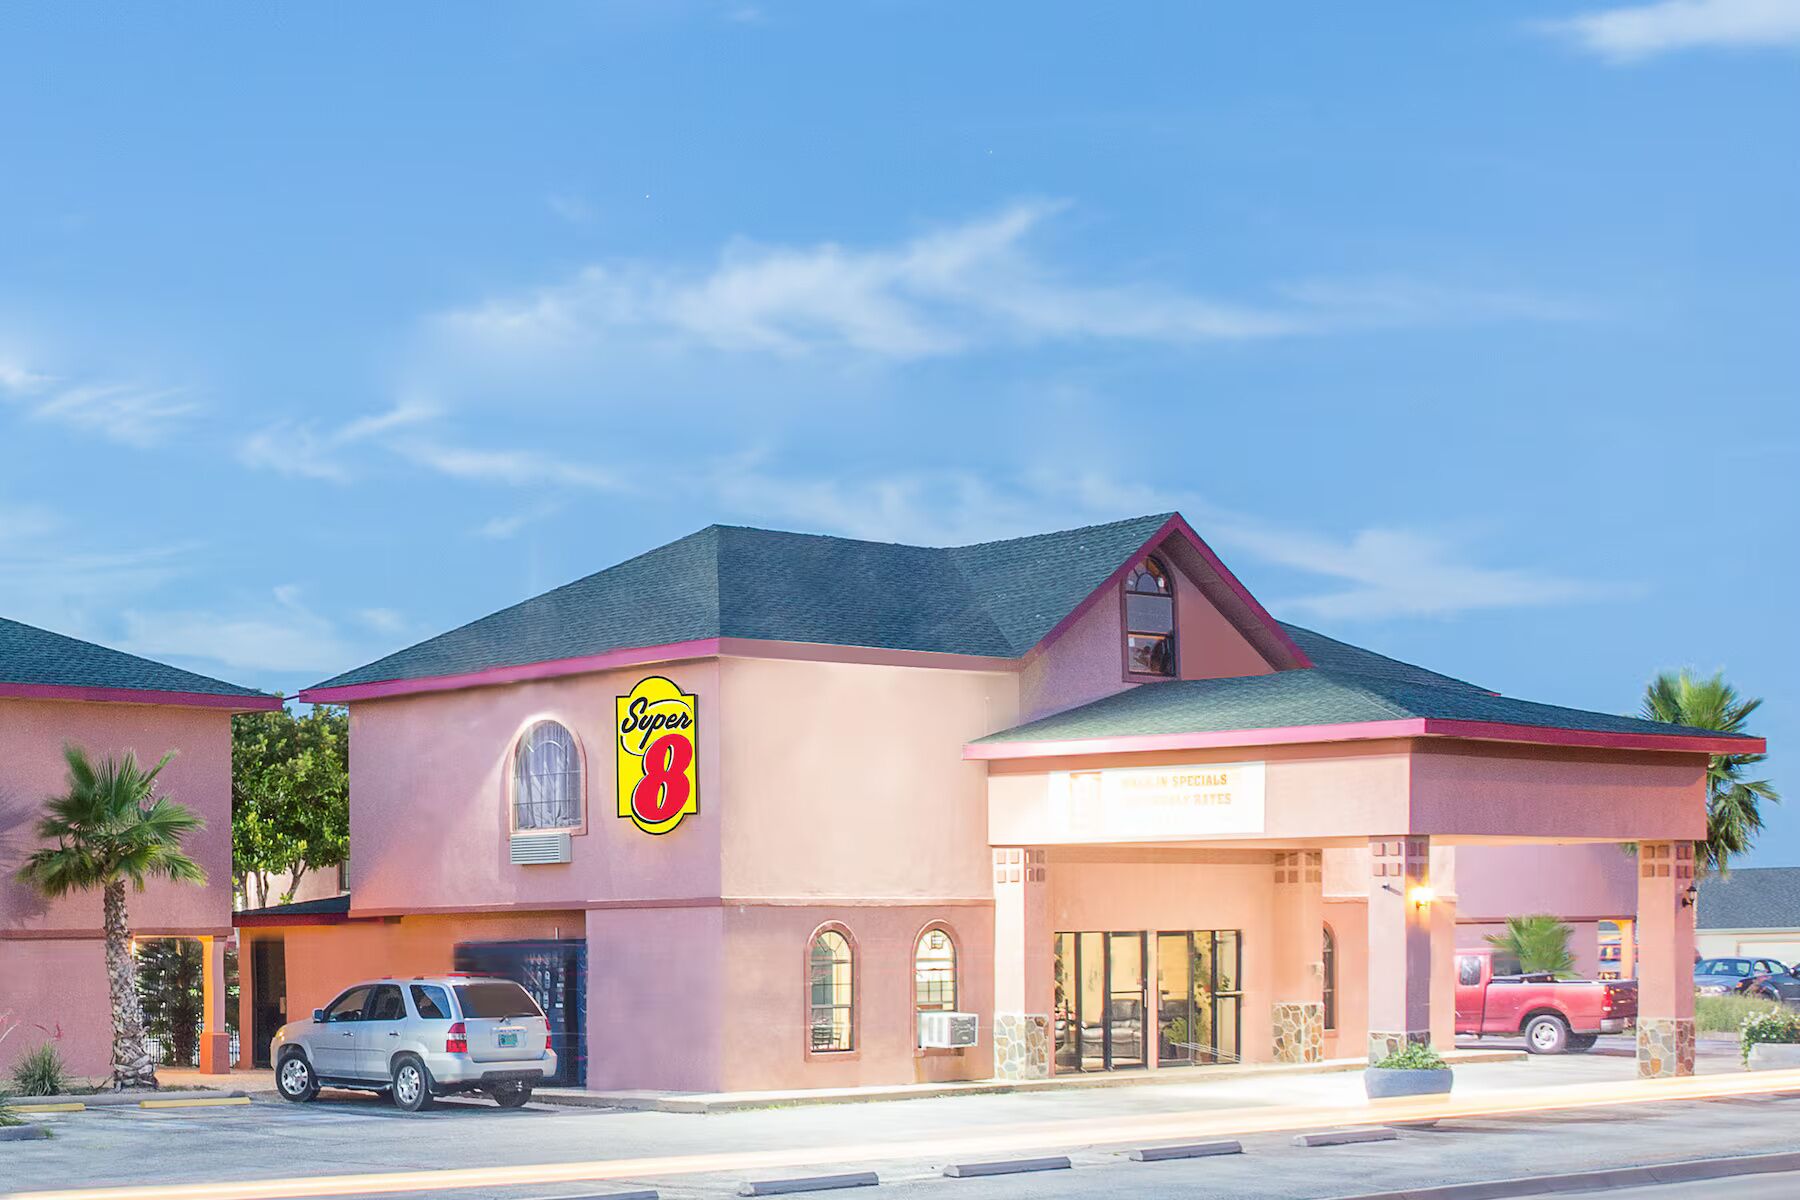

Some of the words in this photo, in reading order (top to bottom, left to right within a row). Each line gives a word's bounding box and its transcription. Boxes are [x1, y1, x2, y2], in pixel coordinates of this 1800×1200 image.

[621, 696, 693, 750] Super
[631, 733, 693, 824] 8
[1173, 774, 1227, 787] SPECIALS
[1194, 793, 1231, 806] RATES
